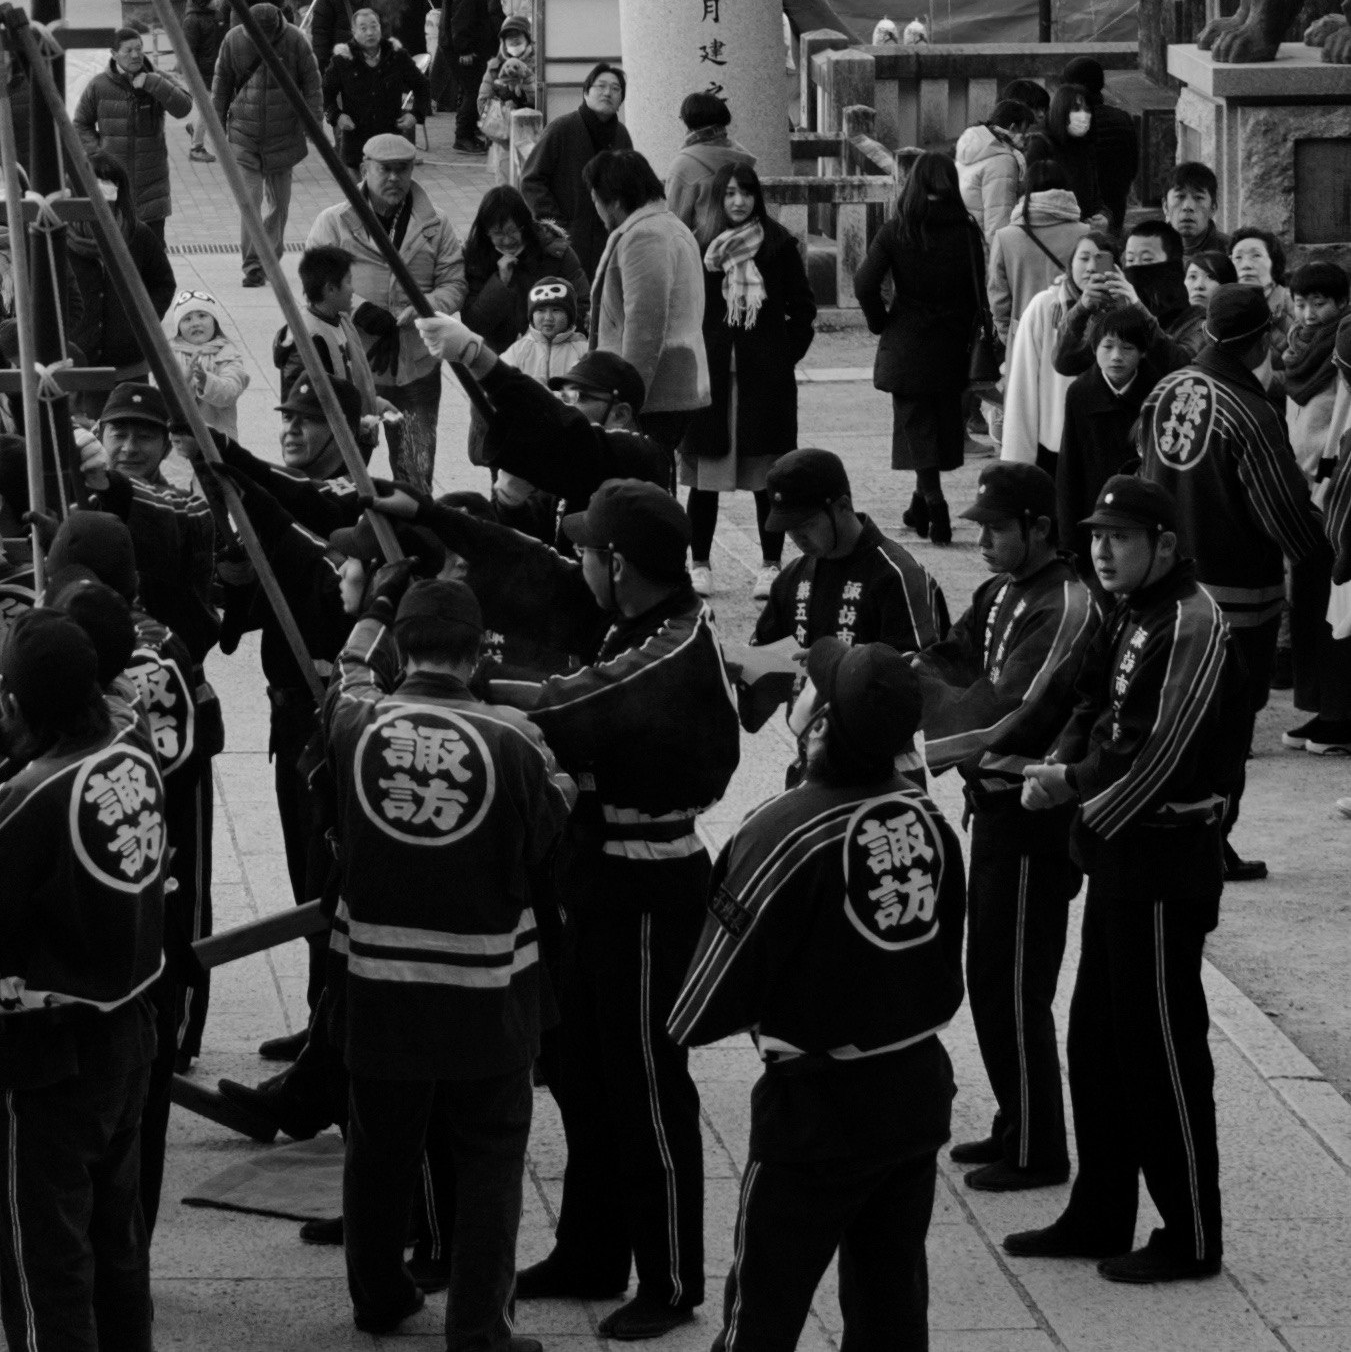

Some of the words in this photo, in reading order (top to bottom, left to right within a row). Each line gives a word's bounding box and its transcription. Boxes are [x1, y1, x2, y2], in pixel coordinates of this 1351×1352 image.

[84, 757, 162, 878] 諏訪
[378, 718, 473, 831] 諏訪
[856, 809, 935, 931] 諏訪
